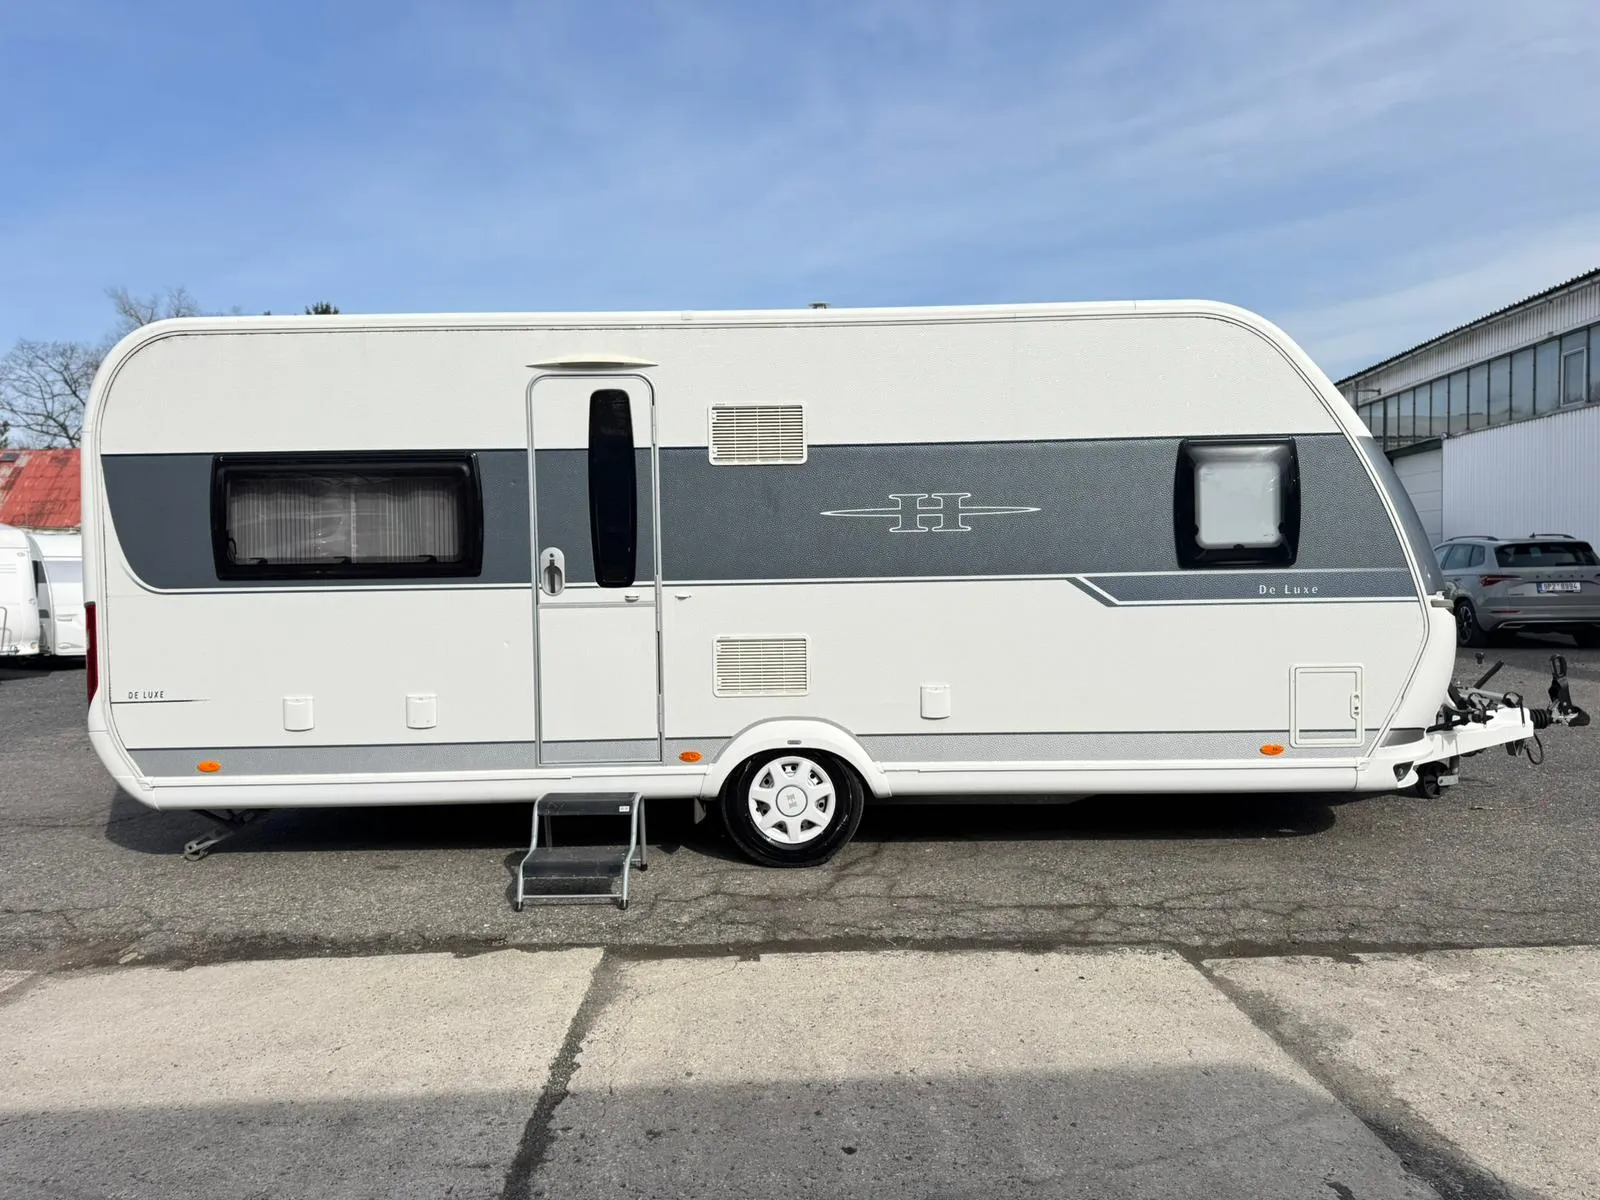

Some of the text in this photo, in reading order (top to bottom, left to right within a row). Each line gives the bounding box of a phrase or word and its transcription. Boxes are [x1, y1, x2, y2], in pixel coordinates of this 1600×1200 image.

[1259, 584, 1319, 595] De Luxe
[128, 690, 164, 700] DE LUXE
